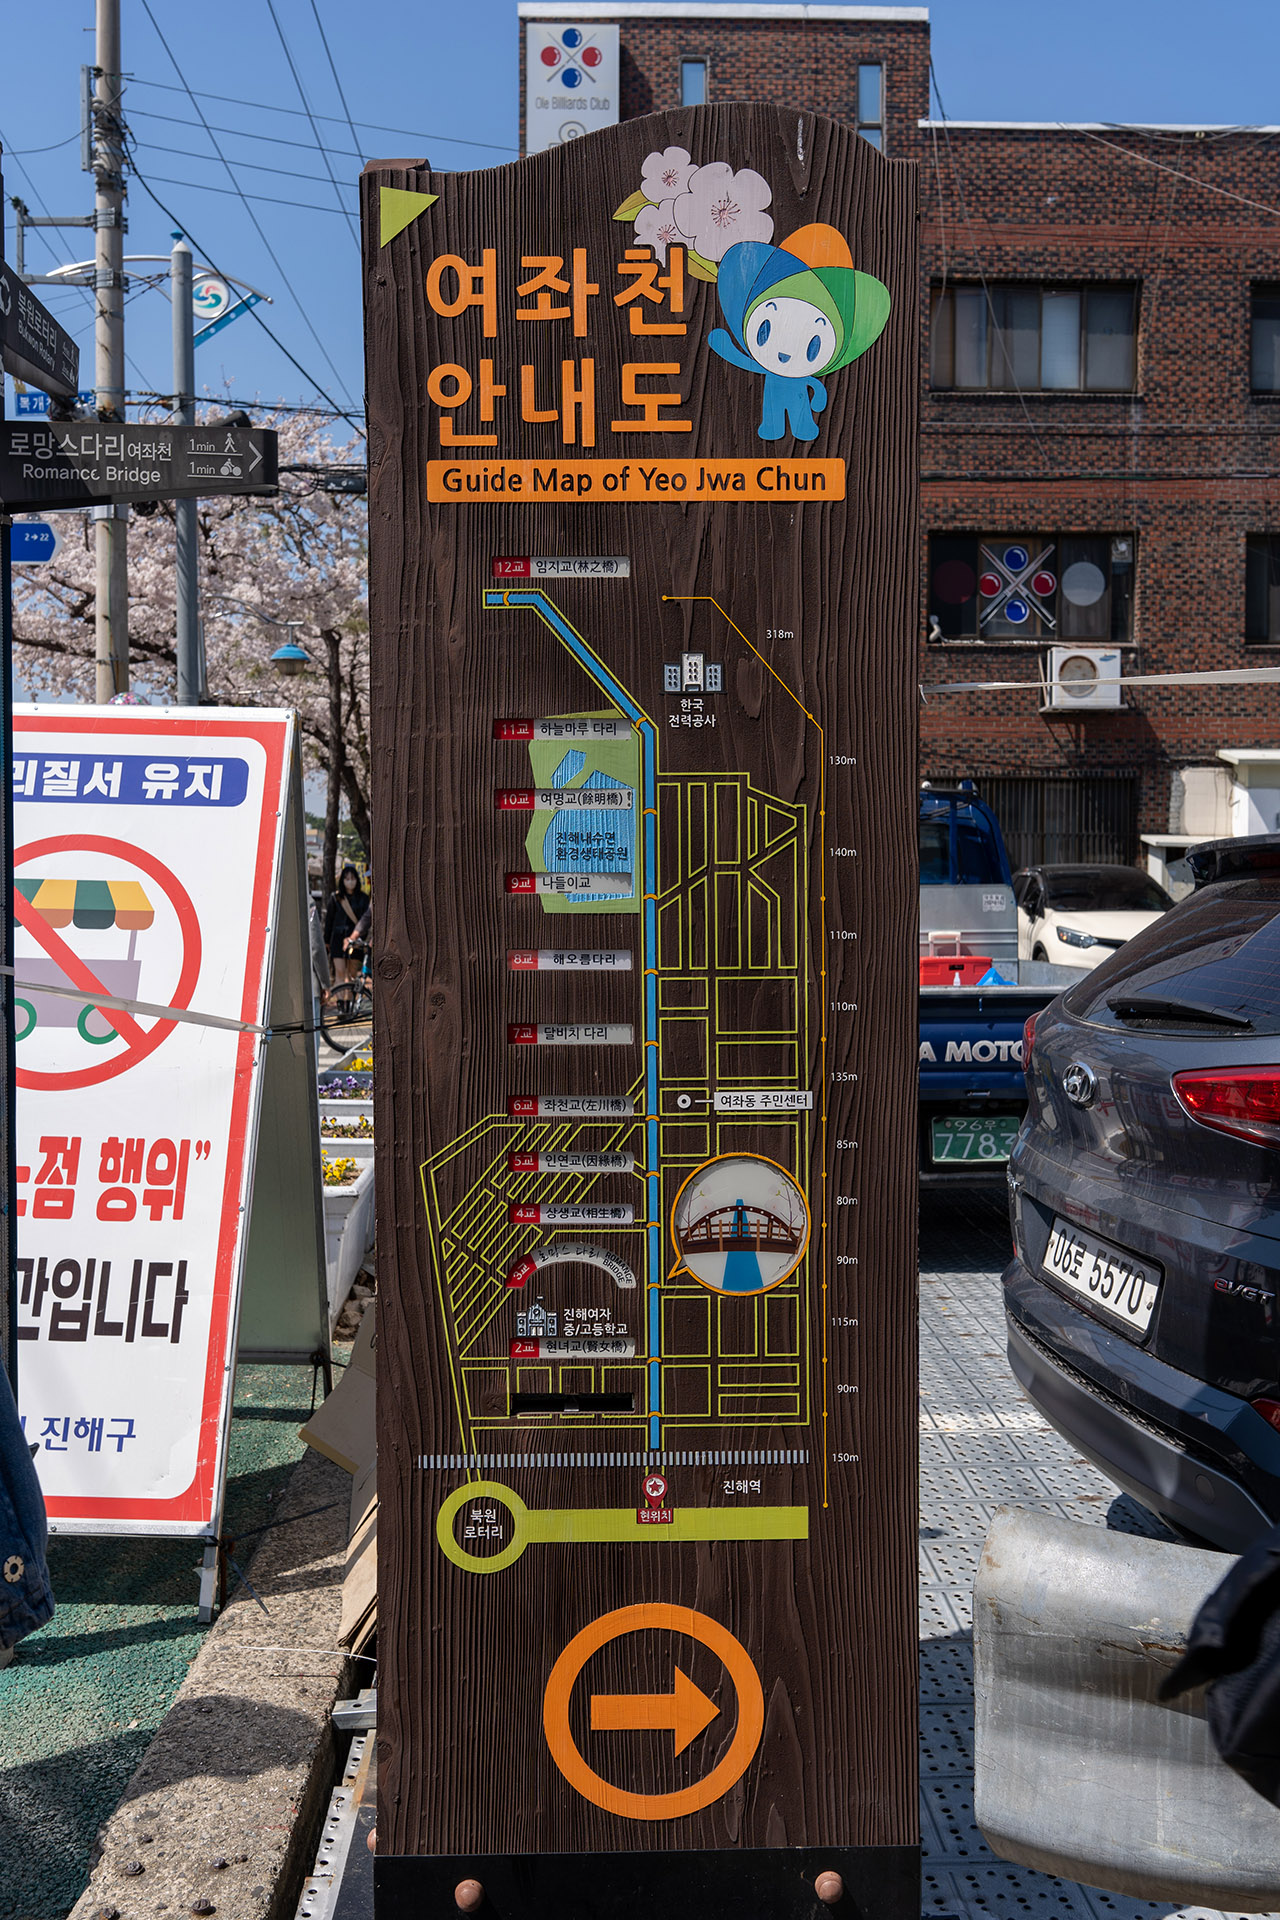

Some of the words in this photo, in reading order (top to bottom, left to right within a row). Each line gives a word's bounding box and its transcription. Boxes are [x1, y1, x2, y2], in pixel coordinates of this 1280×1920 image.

[535, 97, 549, 110] Ole
[551, 96, 588, 110] Billiards
[590, 97, 610, 110] Club
[426, 247, 687, 338] 여좌천
[18, 290, 58, 354] 북원로터리
[18, 319, 39, 352] Bukwon
[39, 340, 56, 371] Rotary
[19, 394, 51, 411] 복개
[427, 358, 692, 447] 안내도
[189, 439, 216, 452] 1min
[23, 463, 100, 481] Romance
[106, 466, 161, 485] Bridge
[189, 462, 216, 475] 1min
[442, 466, 522, 494] Guide
[533, 468, 592, 500] Map
[602, 466, 630, 492] of
[638, 467, 687, 492] Yeo
[696, 466, 746, 493] Jwa
[756, 466, 826, 491] Chun
[497, 561, 525, 573] 12교
[766, 629, 794, 639] 318m
[680, 699, 704, 712] 한국
[668, 714, 716, 728] 전력공사
[501, 723, 529, 735] 11교
[540, 721, 589, 736] 하늘마루
[592, 721, 617, 736] 다리
[829, 755, 857, 765] 130m
[142, 763, 223, 800] 유지
[502, 793, 530, 805] 10교
[556, 831, 616, 846] 진해내수면
[556, 847, 628, 861] 환경생태공원
[829, 847, 857, 857] 140m
[511, 877, 532, 889] 9교
[543, 876, 591, 890] 나들이교
[830, 930, 858, 939] 110m
[514, 954, 534, 965] 8교
[552, 953, 617, 966] 해오름다리
[830, 1002, 858, 1011] 110m
[513, 1027, 534, 1039] 7교
[544, 1026, 580, 1040] 달비치
[584, 1026, 608, 1040] 다리
[831, 1072, 858, 1081] 135m
[513, 1101, 534, 1111] 6교
[720, 1094, 756, 1108] 여좌동
[760, 1094, 808, 1108] 주민센터
[836, 1140, 858, 1149] 85m
[514, 1155, 534, 1166] 5교
[836, 1196, 858, 1205] 80m
[516, 1208, 536, 1218] 4교
[513, 1263, 530, 1280] 3교
[576, 1246, 601, 1259] 다리
[836, 1255, 858, 1265] 90m
[602, 1259, 624, 1283] BRIDGE
[605, 1251, 633, 1284] ROMANCE
[1089, 1248, 1145, 1315] 5570
[563, 1308, 611, 1321] 진해여자
[831, 1317, 859, 1327] 115m
[563, 1323, 628, 1336] 중/고등학교
[515, 1341, 535, 1353] 2교
[836, 1384, 859, 1393] 90m
[39, 1417, 136, 1452] 진해구
[832, 1453, 859, 1462] 150m
[723, 1480, 761, 1494] 진해역
[470, 1508, 496, 1523] 북원
[639, 1509, 671, 1522] 현위치
[464, 1525, 503, 1540] 로터리
